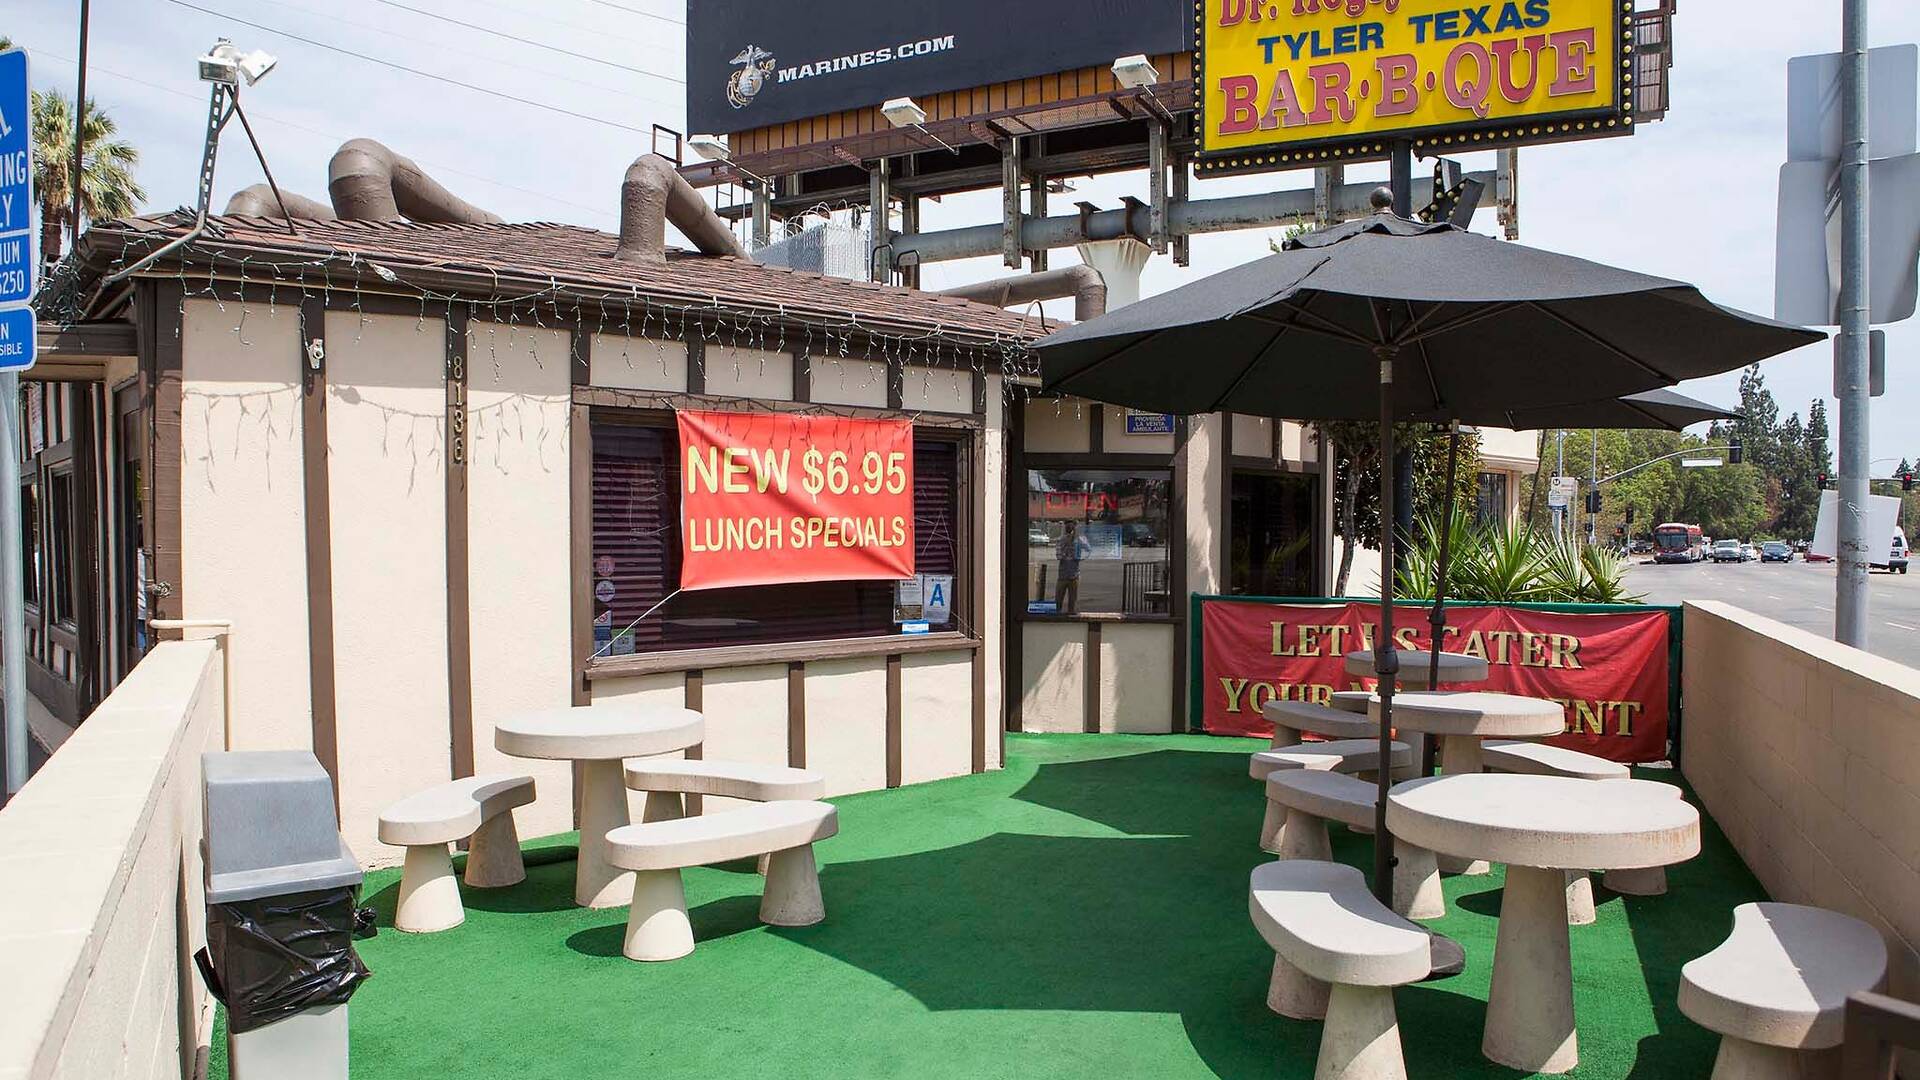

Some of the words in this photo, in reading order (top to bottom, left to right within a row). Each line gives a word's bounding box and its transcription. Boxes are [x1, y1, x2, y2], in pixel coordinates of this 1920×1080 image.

[1257, 22, 1385, 65] TYLER
[1408, 0, 1550, 44] TEXAS
[778, 35, 955, 83] MARINES.COM
[453, 355, 464, 461] 8136
[687, 445, 791, 495] NEW
[801, 443, 907, 505] $6.95
[689, 516, 783, 553] LUNCH
[790, 515, 906, 550] SPECIALS
[929, 583, 945, 607] A
[1269, 621, 1351, 658] LET
[1219, 677, 1335, 714] YOUR
